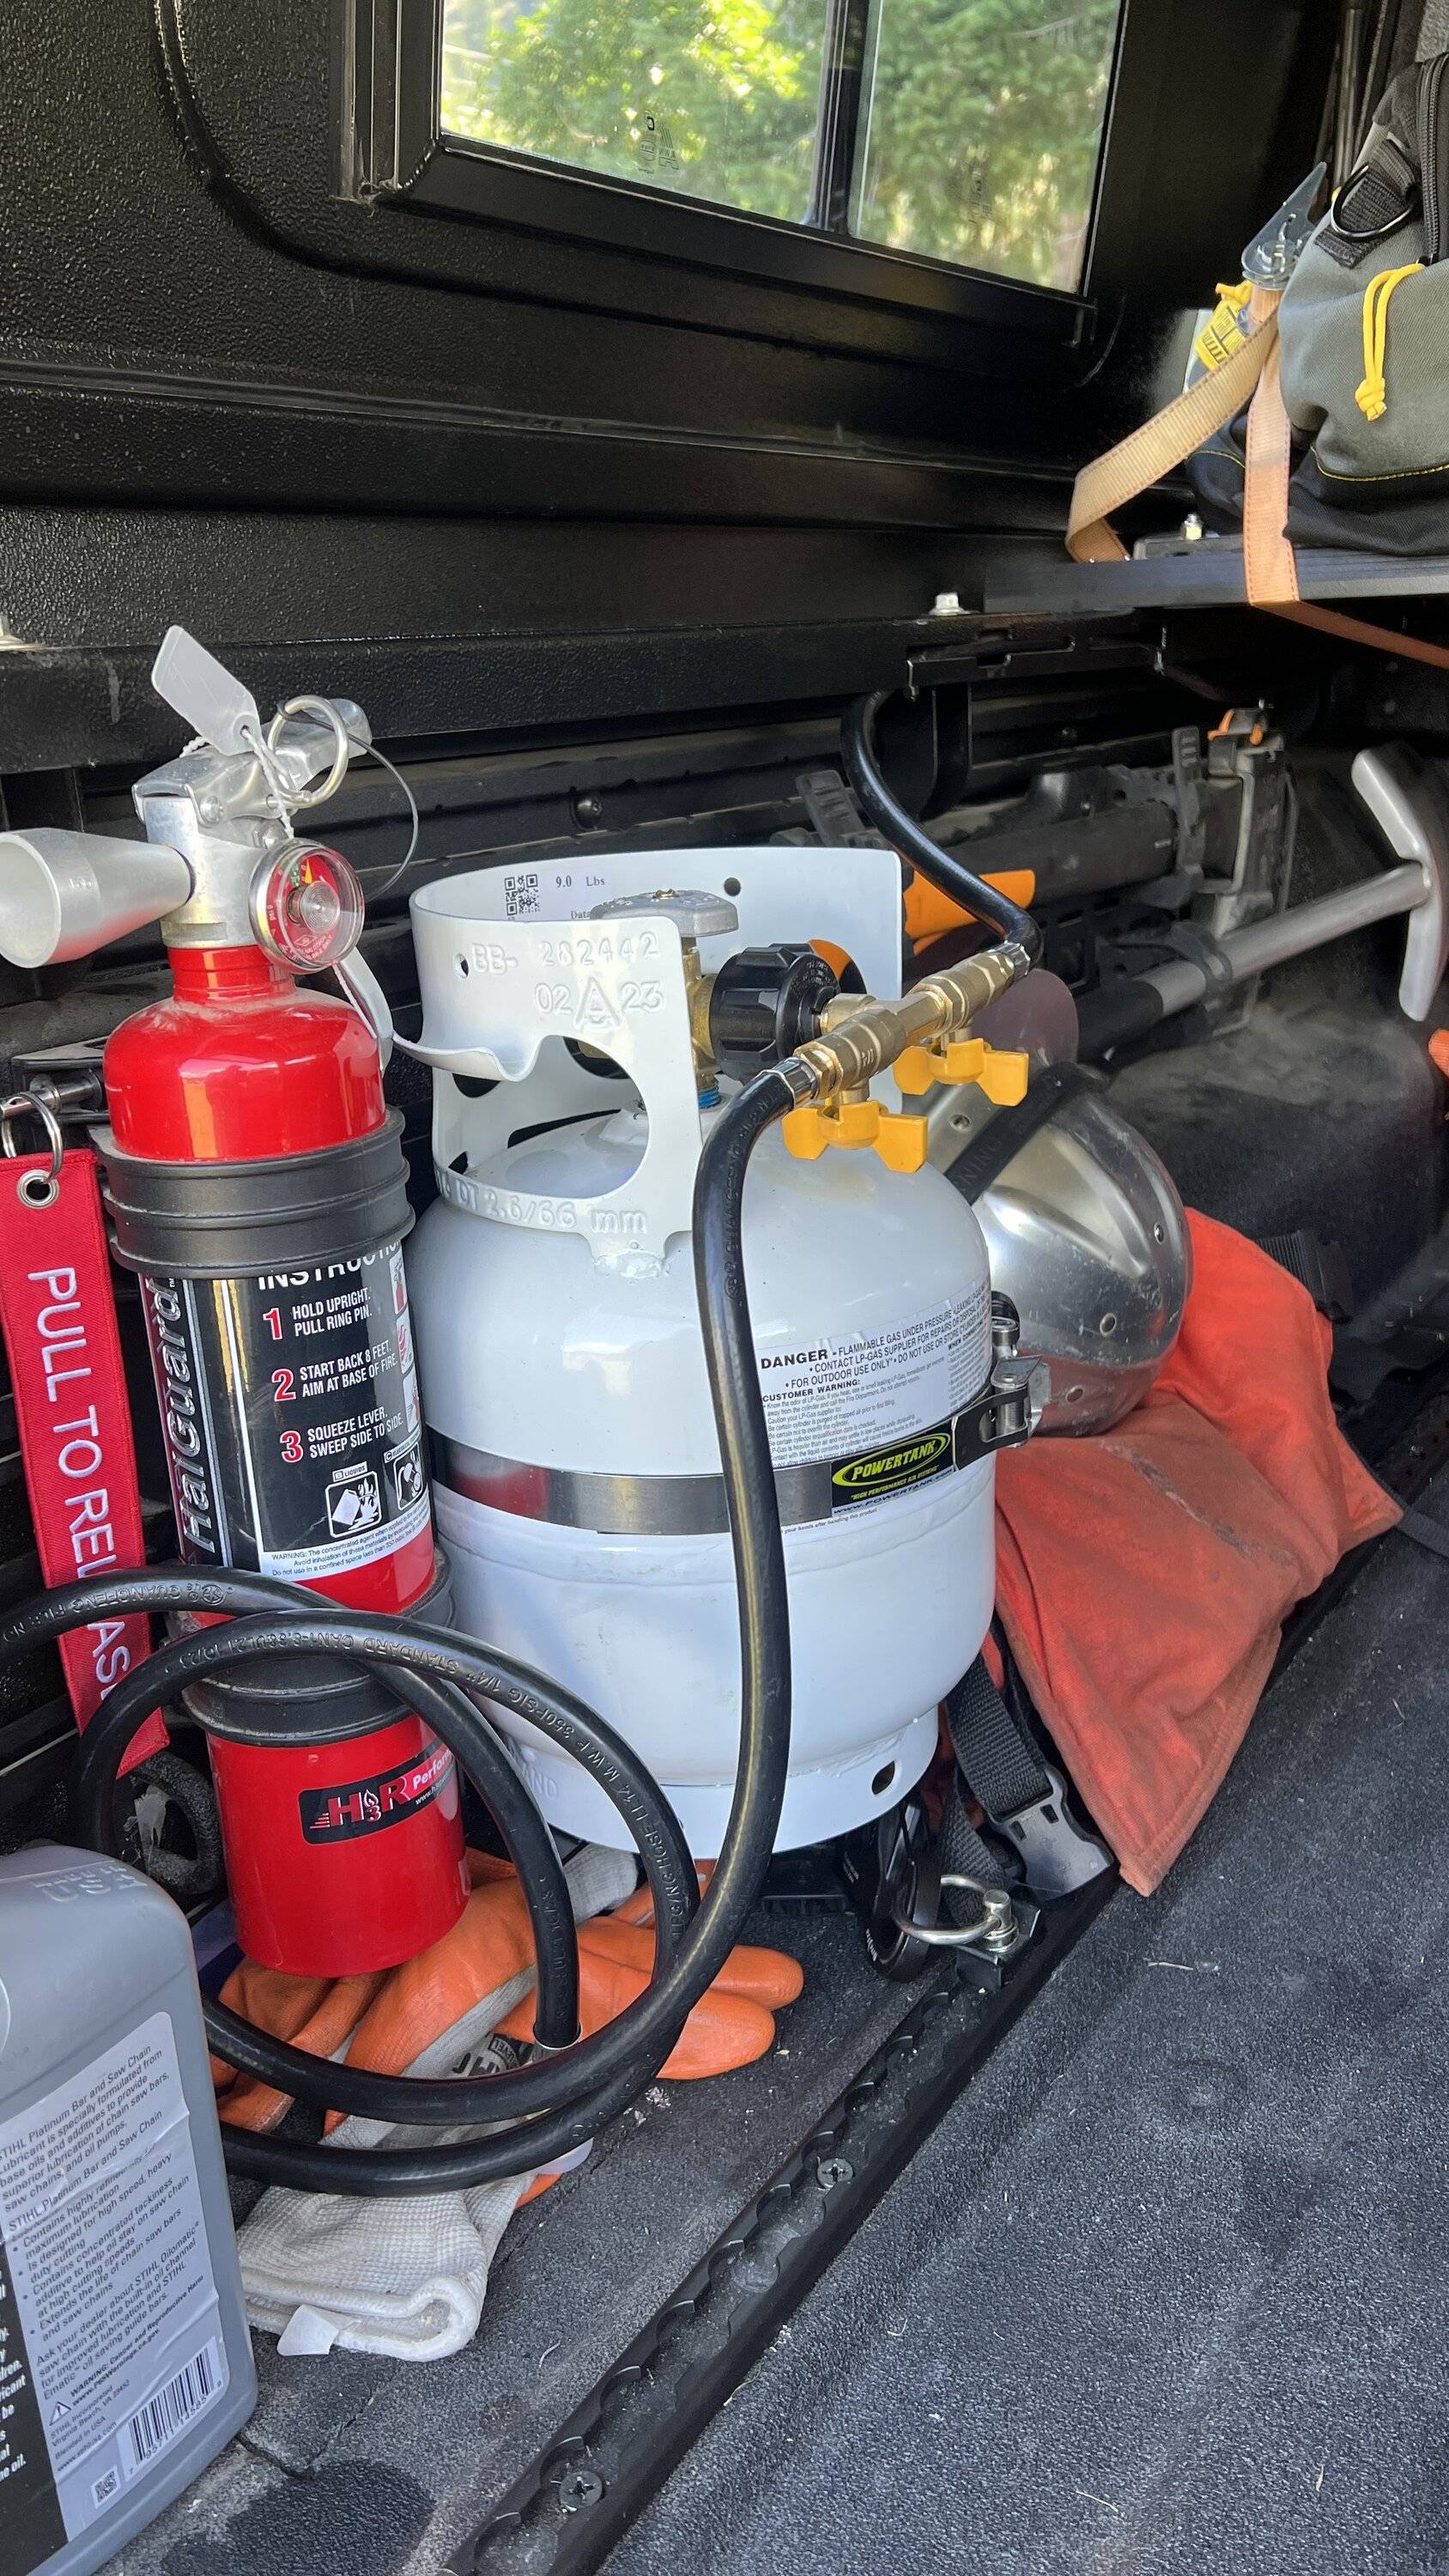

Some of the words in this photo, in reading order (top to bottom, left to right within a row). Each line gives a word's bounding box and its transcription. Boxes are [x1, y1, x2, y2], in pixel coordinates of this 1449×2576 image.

[556, 875, 572, 887] 9.0
[586, 877, 605, 886] Lbs
[591, 1210, 647, 1234] mm
[263, 1307, 282, 1340] 1
[292, 1302, 324, 1320] HOLD
[327, 1287, 371, 1312] UPRIGHT.
[294, 1318, 324, 1337] PULL
[327, 1312, 352, 1330] RING
[355, 1304, 372, 1321] PIN.
[27, 1267, 91, 1401] PULL
[761, 1349, 828, 1370] DANGER
[839, 1336, 885, 1358] FLAMMABLE
[887, 1331, 900, 1344] GAS
[902, 1323, 923, 1339] UNDER
[925, 1309, 952, 1329] PRESSURE
[815, 1357, 853, 1373] CONTACT
[855, 1349, 883, 1364] LP-GAS
[885, 1337, 916, 1356] SUPPLIER
[918, 1333, 929, 1344] FOR
[300, 1361, 335, 1380] START
[338, 1354, 366, 1371] BACK
[365, 1350, 371, 1363] 8
[373, 1340, 391, 1359] FEET.
[302, 1382, 324, 1397] AIM
[327, 1377, 339, 1392] AT
[343, 1370, 367, 1388] BASE
[368, 1364, 379, 1378] OF
[381, 1353, 398, 1371] FIRE.
[791, 1377, 809, 1388] FOR
[811, 1369, 852, 1384] OUTDOOR
[854, 1364, 869, 1376] USE
[898, 1353, 907, 1364] DO
[909, 1346, 921, 1358] NOT
[923, 1342, 934, 1353] USE
[272, 1369, 296, 1401] 2
[763, 1388, 813, 1402] CUSTOMER
[817, 1379, 860, 1394] WARNING:
[52, 1405, 103, 1479] TO
[280, 1431, 303, 1463] 3
[307, 1418, 356, 1442] SQUEEZE
[358, 1406, 387, 1428] LEVER.
[310, 1437, 348, 1458] SWEEP
[350, 1430, 372, 1448] SIDE
[373, 1423, 385, 1437] TO
[387, 1413, 403, 1432] SIDE.
[64, 1489, 131, 1700] RELAS
[70, 1584, 180, 1613] GUANGFENG
[363, 1637, 459, 1674] STANDARD
[28, 2110, 70, 2142] Platinum
[72, 2095, 87, 2112] Bar
[89, 2080, 106, 2099] and
[107, 2066, 125, 2084] Saw
[128, 2046, 151, 2068] Chain
[58, 2103, 96, 2136] specially
[98, 2064, 142, 2105] formulated
[143, 2050, 162, 2069] from
[3, 2169, 44, 2200] superior
[46, 2133, 93, 2172] lubrication
[106, 2104, 130, 2126] chain
[130, 2089, 148, 2106] saw
[28, 2155, 45, 2171] oils
[48, 2138, 65, 2158] and
[68, 2109, 106, 2143] additives
[118, 2075, 148, 2105] provide
[42, 2177, 82, 2211] Platinum
[83, 2162, 99, 2179] Bar
[101, 2145, 118, 2166] and
[118, 2131, 137, 2150] Saw
[139, 2111, 162, 2134] Chain
[66, 2153, 83, 2172] and
[26, 2222, 72, 2260] maximum
[74, 2184, 119, 2225] lubrication
[39, 2226, 82, 2263] designed
[98, 2200, 117, 2219] high
[148, 2154, 172, 2178] heavy
[67, 2191, 94, 2216] highly
[33, 2261, 74, 2295] Contains
[76, 2210, 134, 2263] concentrated
[135, 2178, 173, 2215] tackiness
[36, 2275, 72, 2306] additive
[85, 2250, 105, 2269] help
[118, 2223, 136, 2242] stay
[168, 2176, 189, 2199] chain
[31, 2265, 51, 2283] duty
[54, 2239, 86, 2267] cutting
[39, 2298, 77, 2330] Extends
[95, 2273, 108, 2287] life
[121, 2243, 144, 2266] chain
[145, 2226, 162, 2242] saw
[163, 2208, 181, 2228] bars
[49, 2291, 70, 2310] high
[72, 2265, 103, 2293] cutting
[105, 2238, 135, 2267] speeds
[39, 2359, 59, 2375] saw
[62, 2337, 88, 2361] chain
[88, 2320, 108, 2339] with
[110, 2306, 124, 2322] the
[166, 2238, 196, 2272] channel
[57, 2332, 77, 2352] your
[80, 2306, 106, 2334] dealer
[110, 2283, 134, 2309] about
[136, 2261, 160, 2286] STIHL
[57, 2337, 100, 2378] improved
[100, 2300, 145, 2342] lubrication
[163, 2262, 185, 2287] STIHL
[63, 2308, 82, 2327] saw
[84, 2282, 113, 2310] chains
[94, 2333, 123, 2360] saving
[124, 2311, 147, 2336] guide
